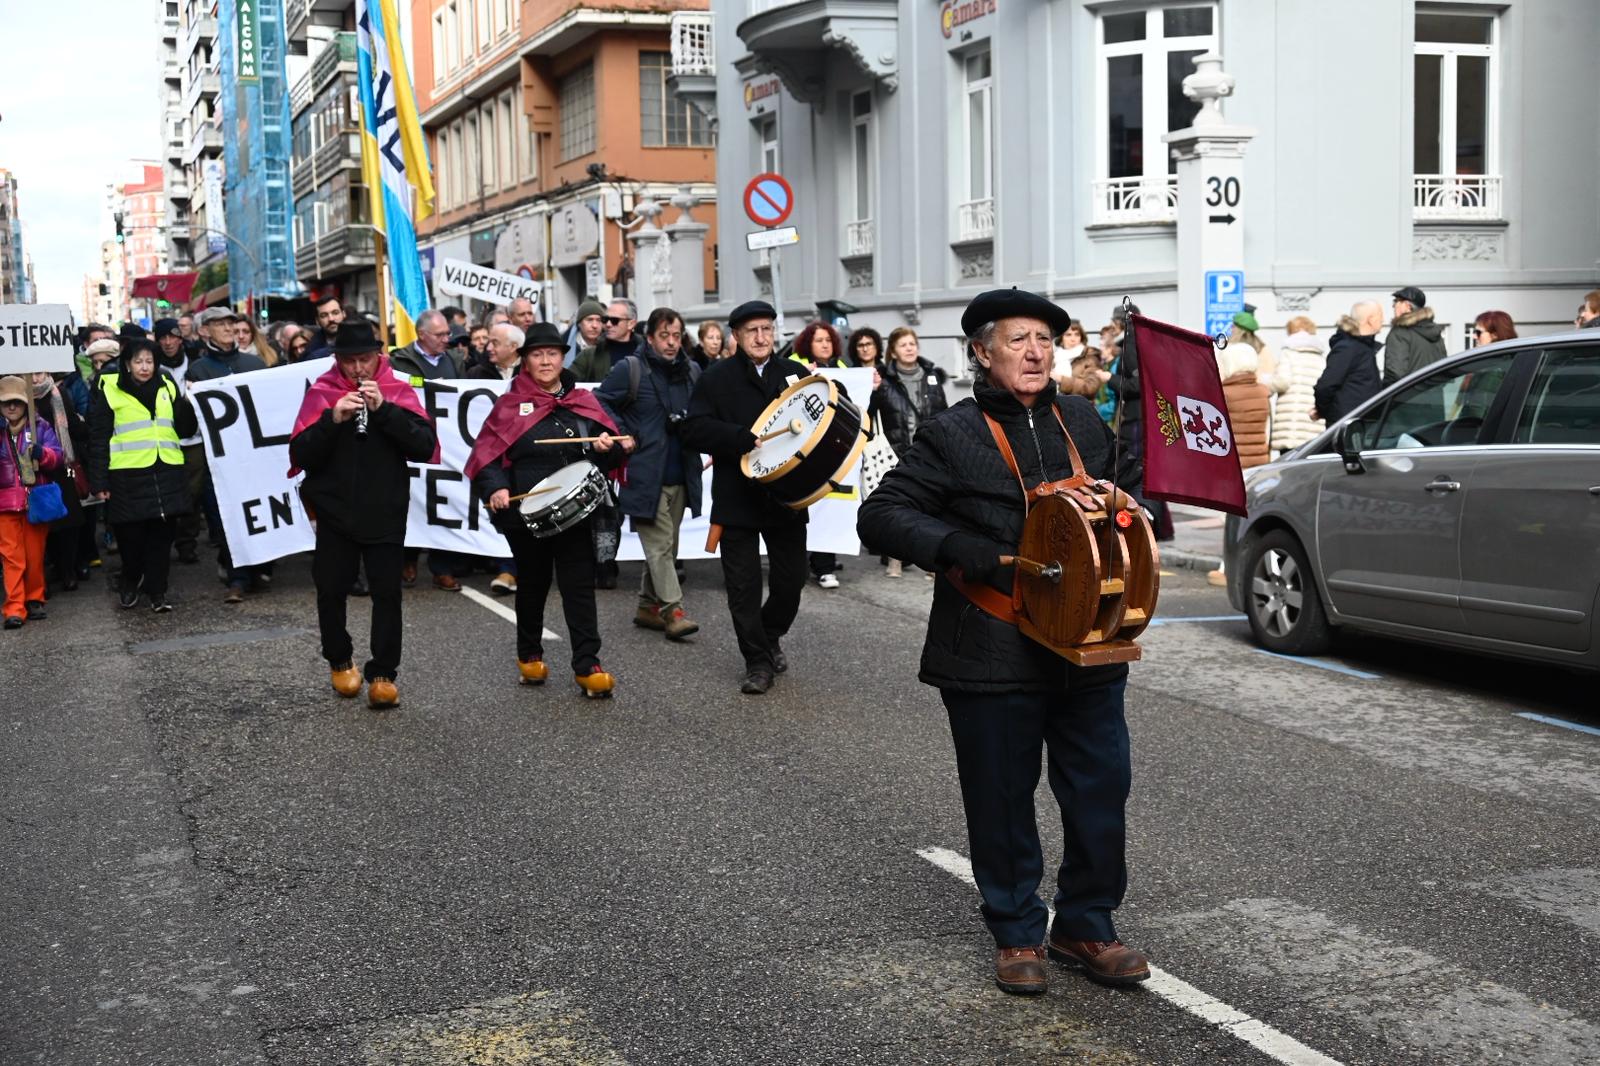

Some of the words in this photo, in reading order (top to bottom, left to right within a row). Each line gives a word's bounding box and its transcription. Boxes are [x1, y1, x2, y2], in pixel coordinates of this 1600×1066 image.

[1206, 176, 1241, 208] 30
[1216, 275, 1236, 304] P
[242, 492, 294, 536] EN
